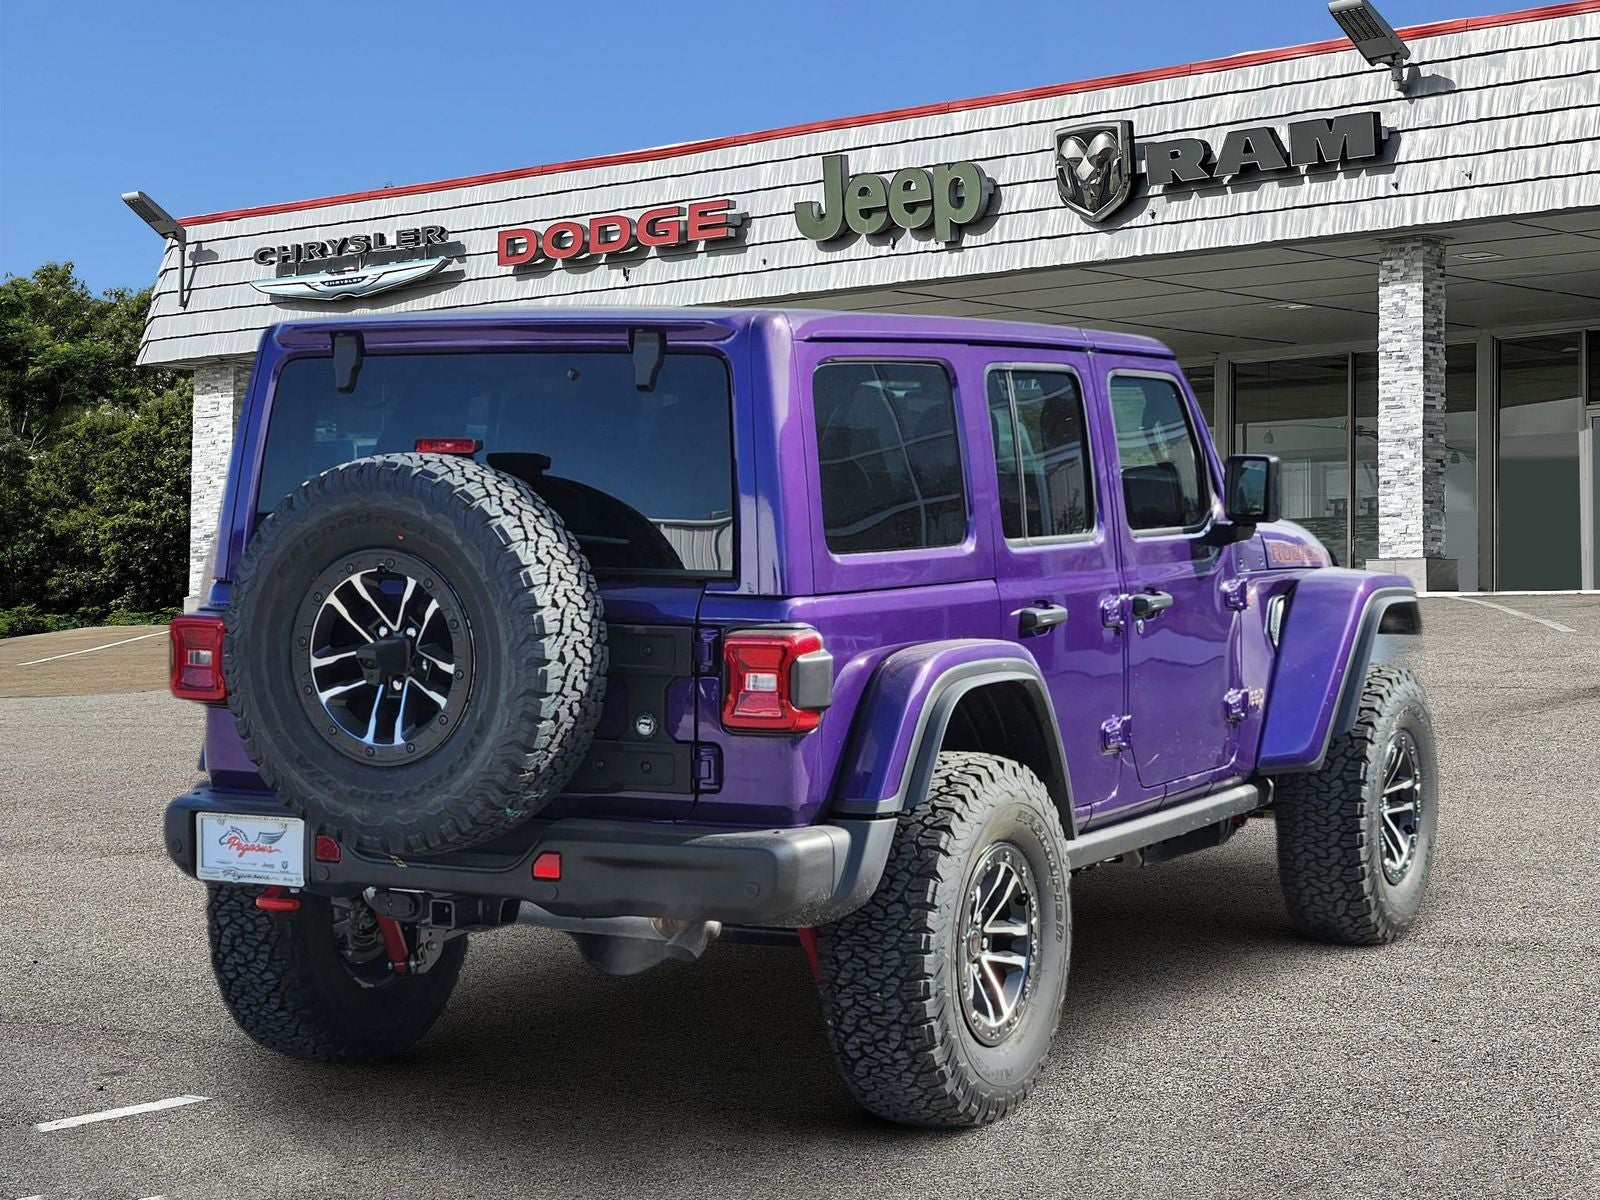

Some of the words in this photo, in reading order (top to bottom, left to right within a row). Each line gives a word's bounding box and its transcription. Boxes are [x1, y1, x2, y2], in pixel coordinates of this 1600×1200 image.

[1144, 111, 1379, 186] RAM
[795, 155, 992, 243] Jeep
[253, 225, 448, 266] CHRYSLER
[497, 199, 735, 267] DODGE
[323, 277, 363, 287] CHRYSLER
[226, 835, 281, 858] Pegasus
